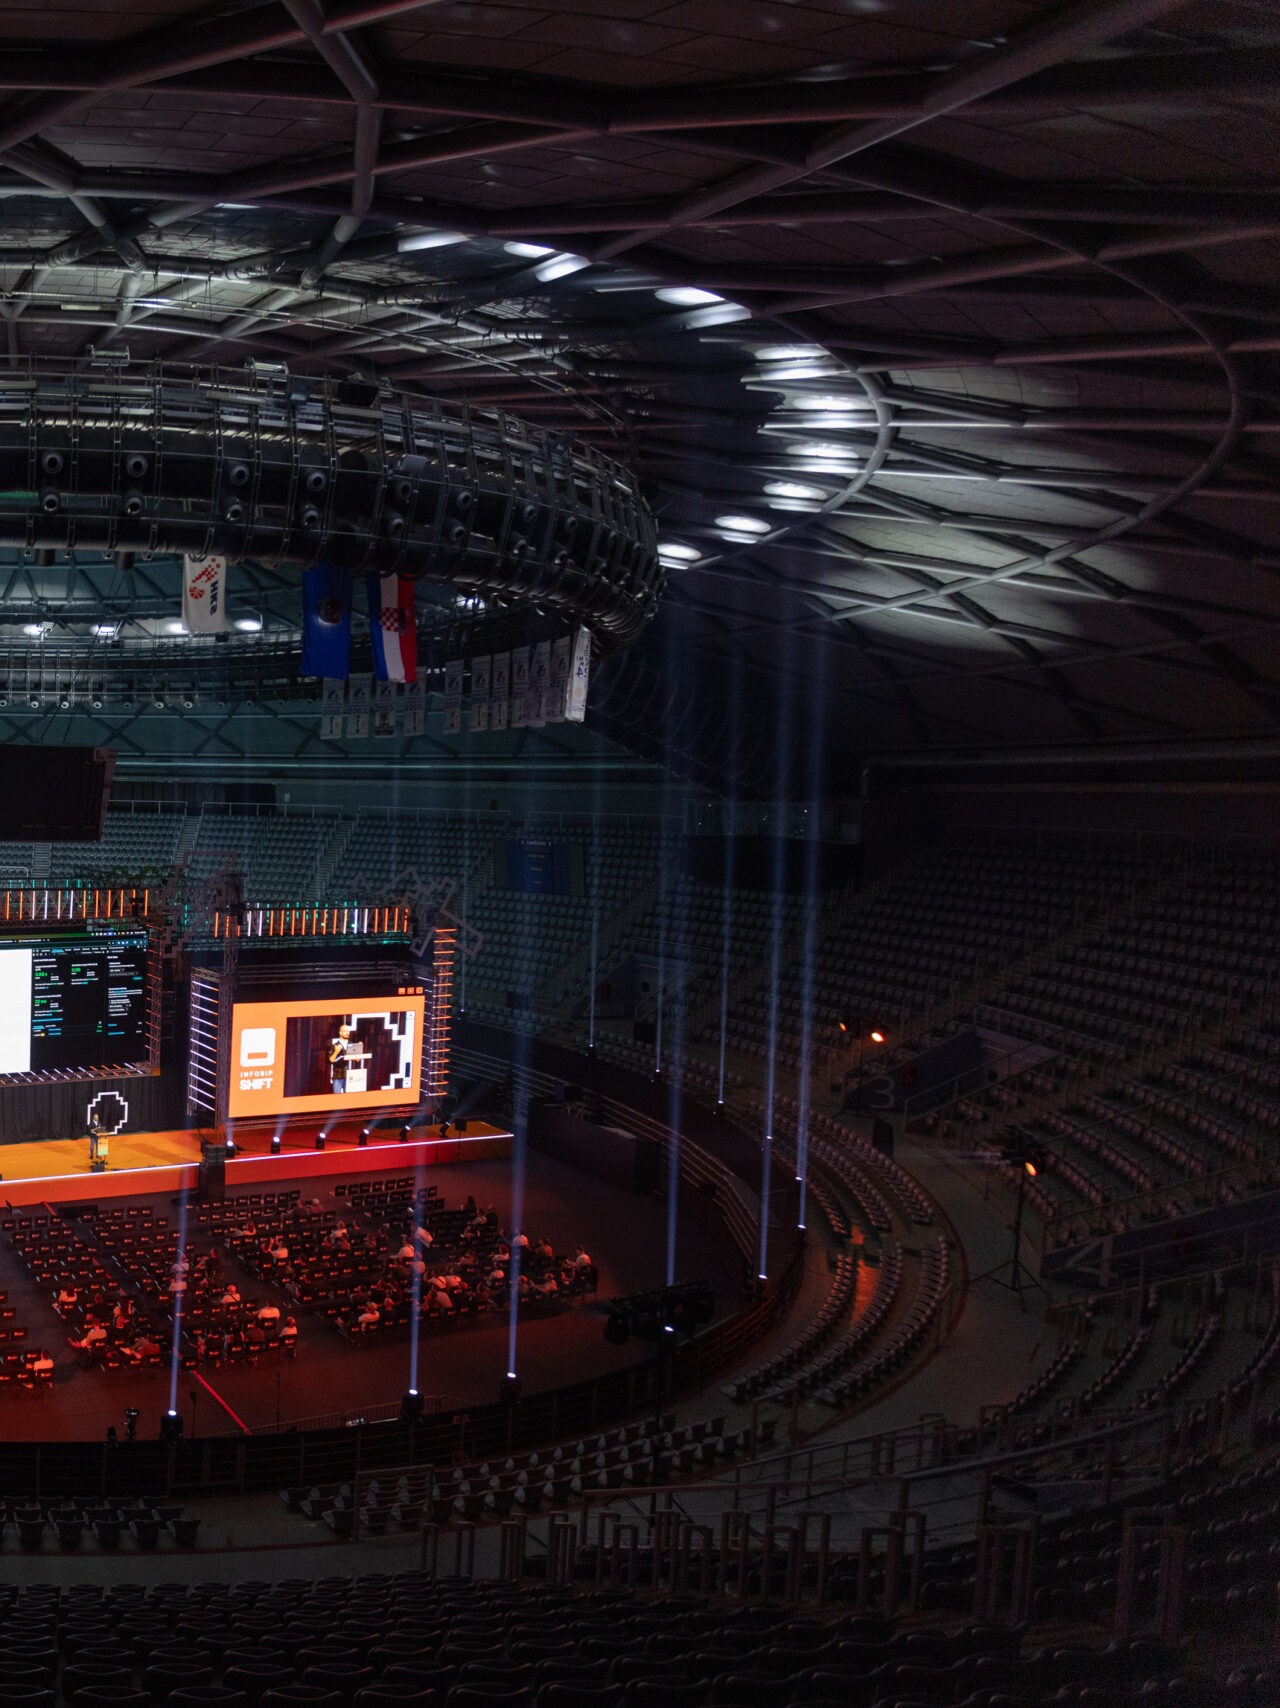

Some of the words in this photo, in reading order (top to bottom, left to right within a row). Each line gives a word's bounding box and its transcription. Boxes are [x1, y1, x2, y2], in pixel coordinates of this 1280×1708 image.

[240, 1070, 274, 1078] INFOBIP
[239, 1078, 274, 1091] SHIFT
[869, 1075, 896, 1109] 3
